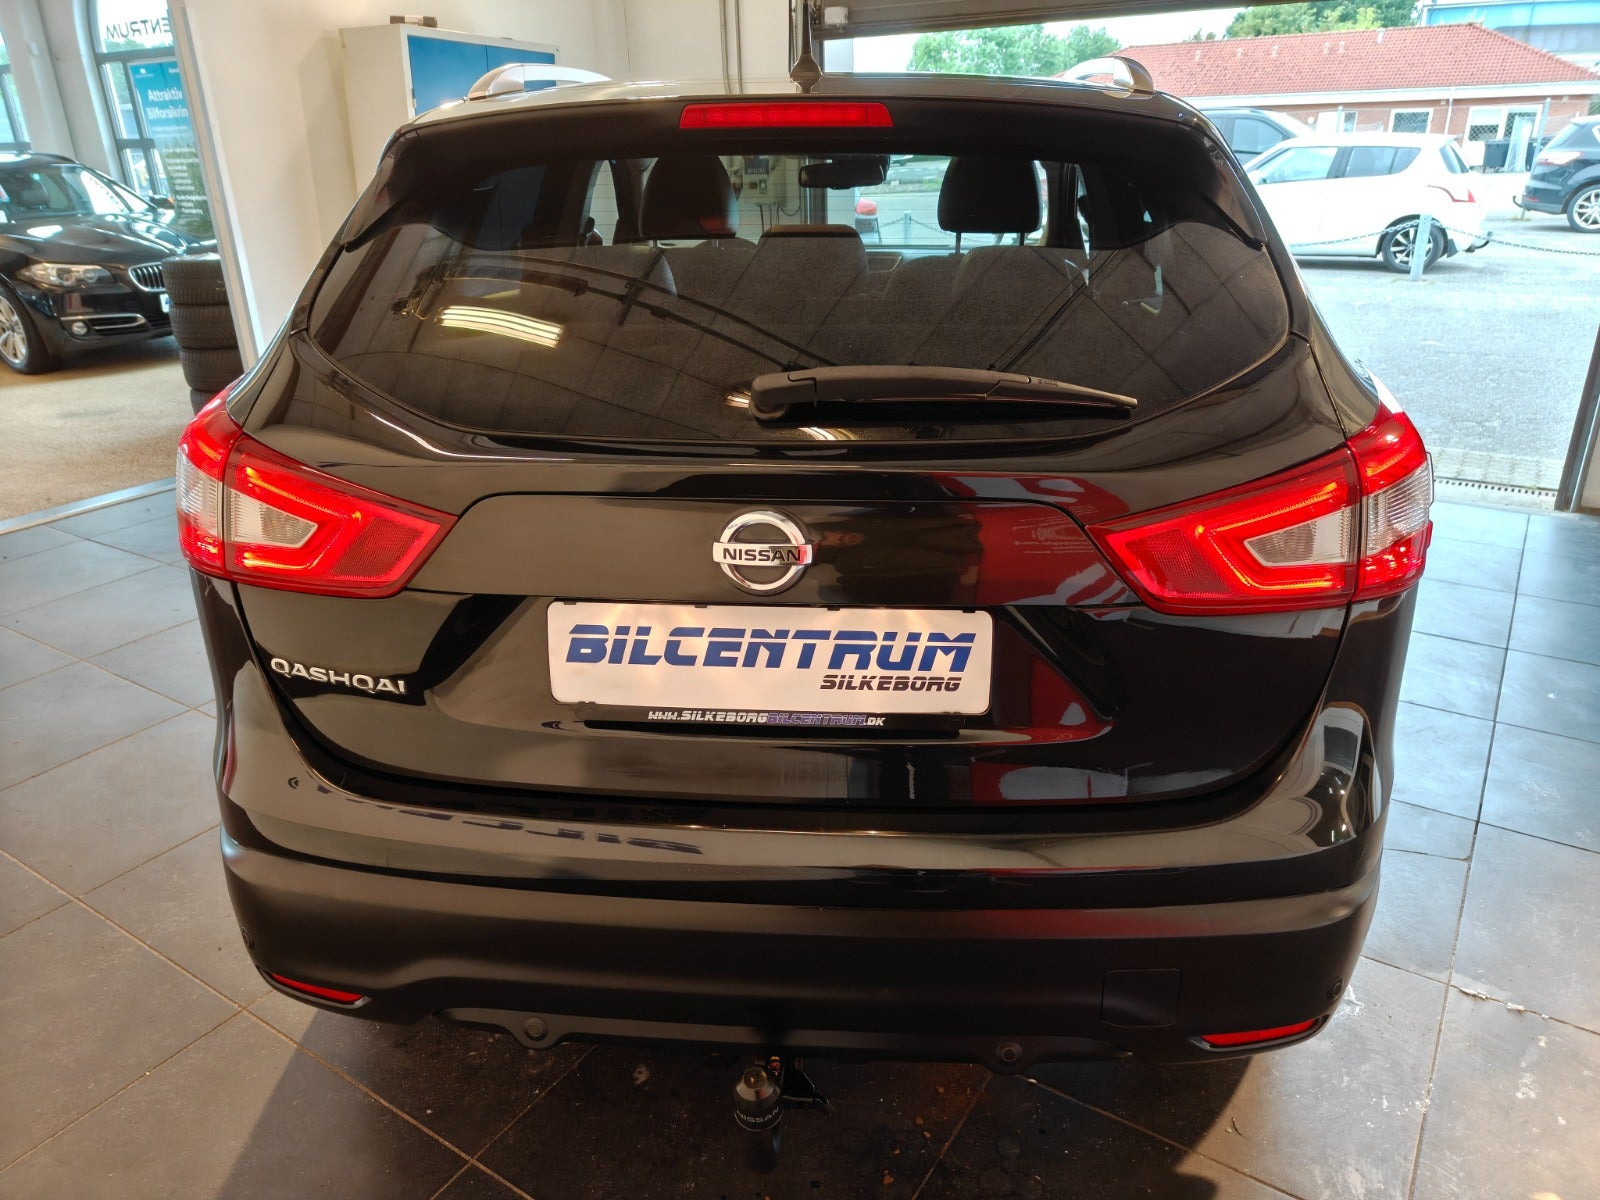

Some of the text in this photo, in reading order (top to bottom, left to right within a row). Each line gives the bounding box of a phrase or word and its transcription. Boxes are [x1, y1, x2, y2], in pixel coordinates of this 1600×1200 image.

[147, 88, 183, 102] Attraktiv
[723, 546, 801, 562] NISSAN
[566, 624, 976, 672] BILCENTRUM
[270, 657, 407, 694] QASHQAI
[820, 674, 962, 692] SILKEBORG
